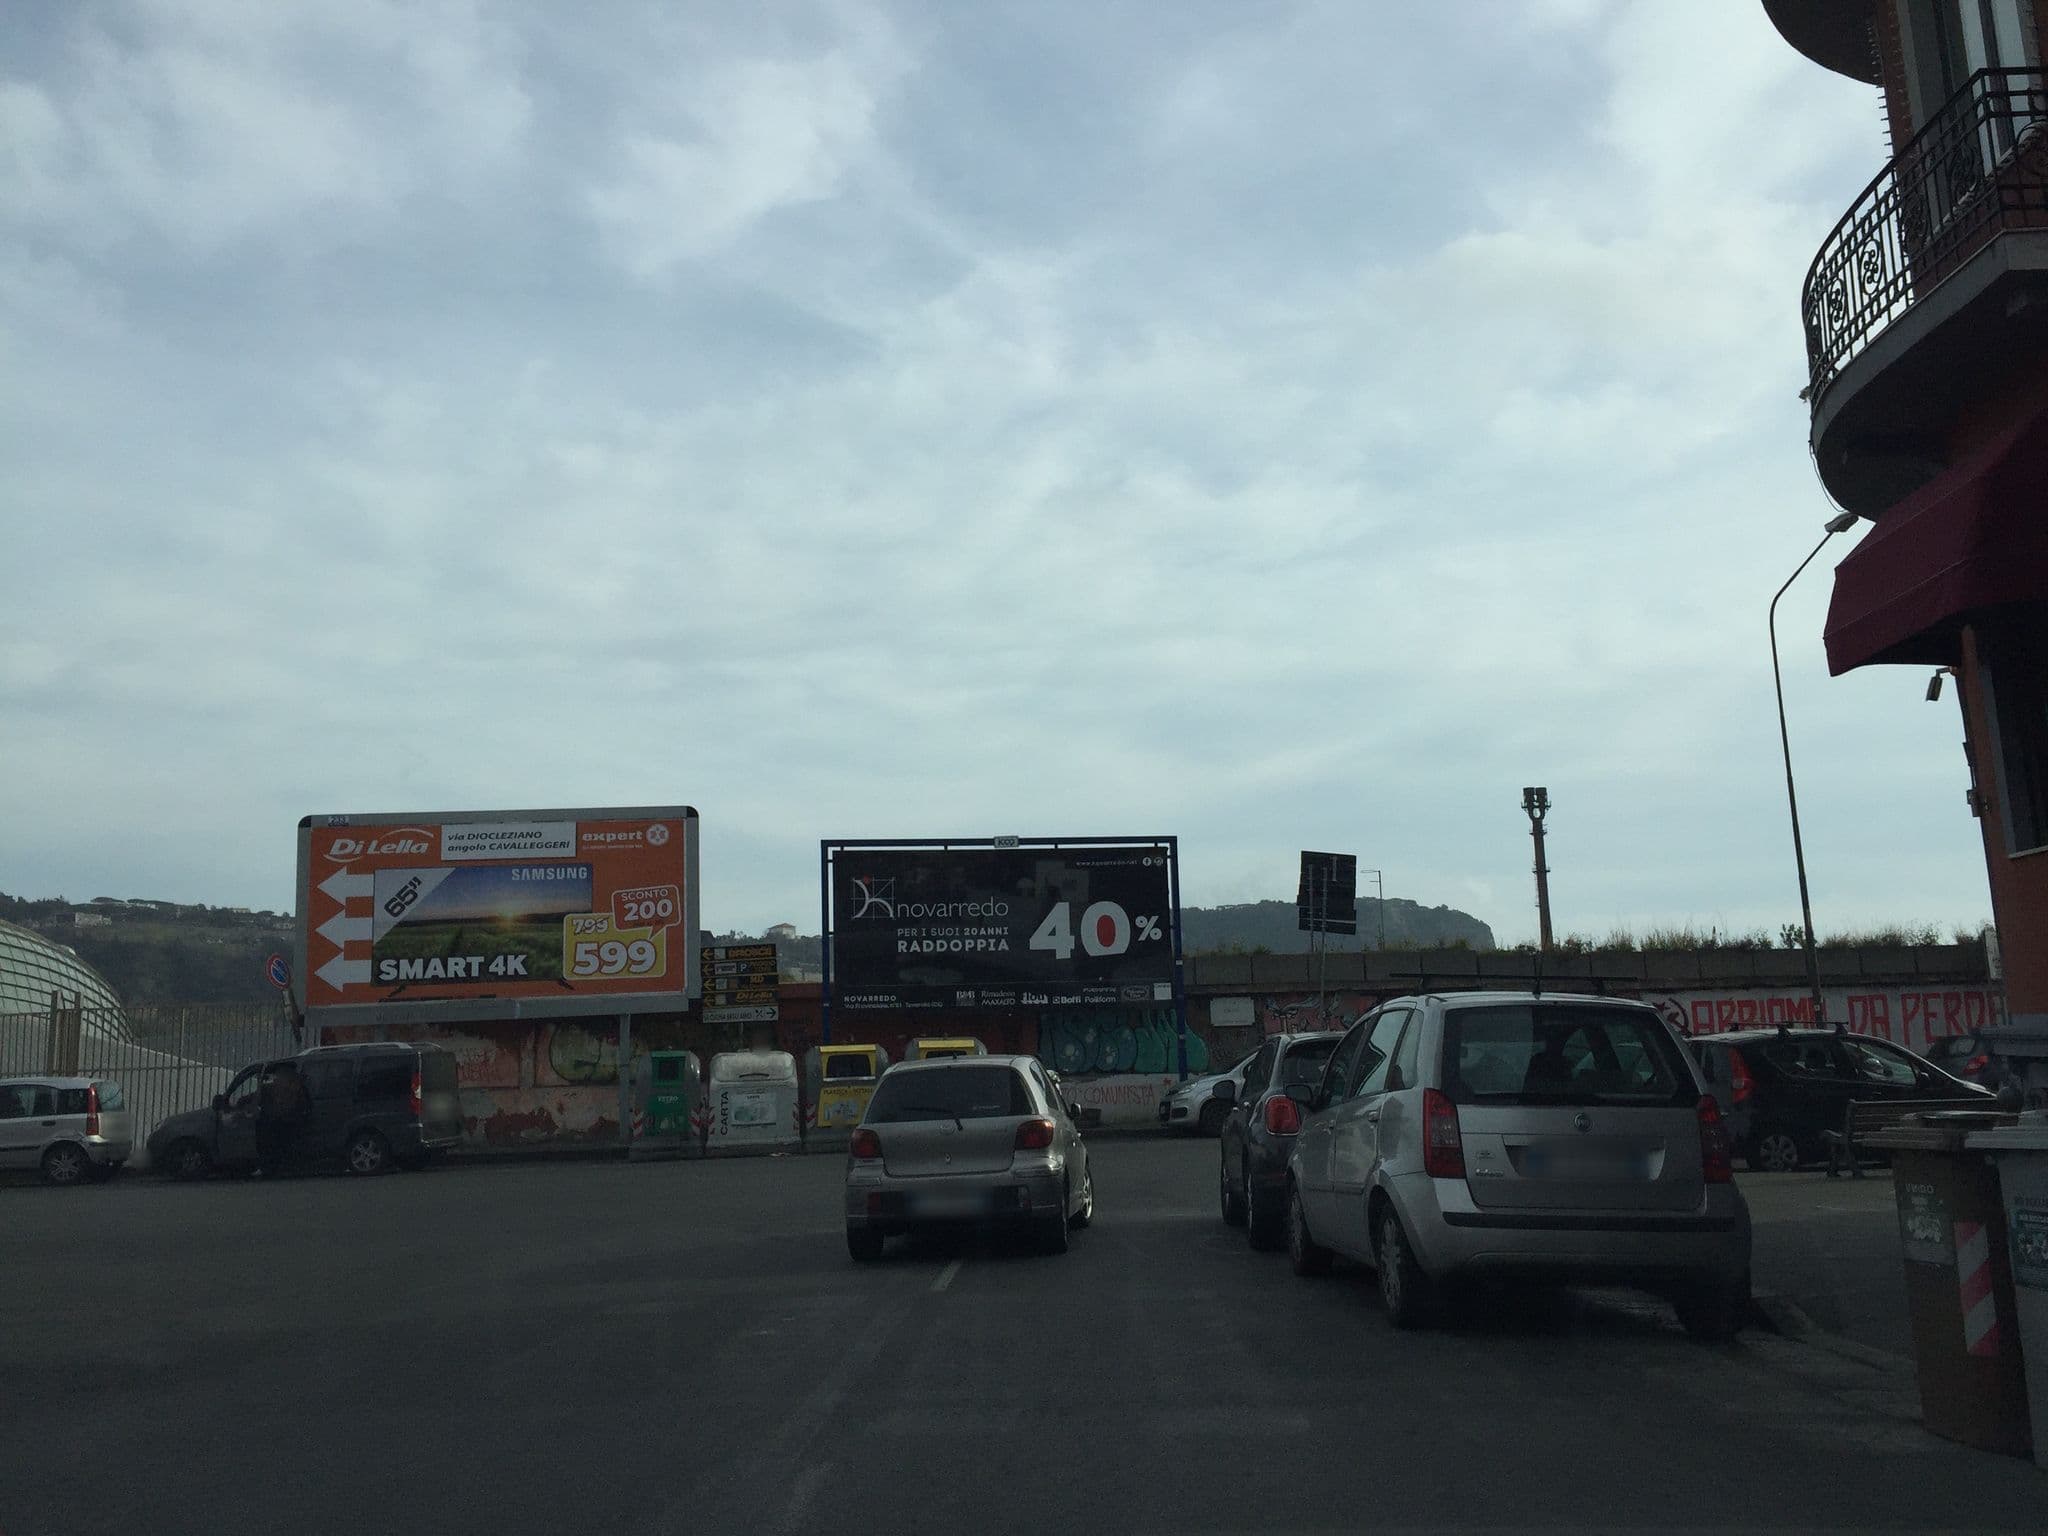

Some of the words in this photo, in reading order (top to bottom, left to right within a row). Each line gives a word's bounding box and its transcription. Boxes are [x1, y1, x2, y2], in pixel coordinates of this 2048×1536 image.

[447, 833, 465, 842] via
[467, 831, 542, 841] DIOCLEZIANO
[582, 831, 643, 843] expert
[329, 838, 365, 855] Di
[367, 839, 430, 855] Lella
[447, 843, 486, 853] angolo
[489, 840, 570, 851] CAVALLEGGERI
[511, 866, 588, 881] SAMSUNG
[620, 888, 669, 902] SCONTO
[623, 900, 673, 922] 200
[897, 896, 1009, 918] novarredo
[571, 917, 608, 935] 799
[897, 928, 917, 937] PER
[920, 928, 927, 937] I
[930, 927, 960, 937] SUOI
[897, 939, 1010, 953] RADDOPPIA
[572, 940, 657, 976] 599
[378, 956, 484, 982] SMART
[488, 954, 528, 977] 4K
[843, 995, 897, 1003] NOVARREDO
[720, 1091, 729, 1136] CARTA
